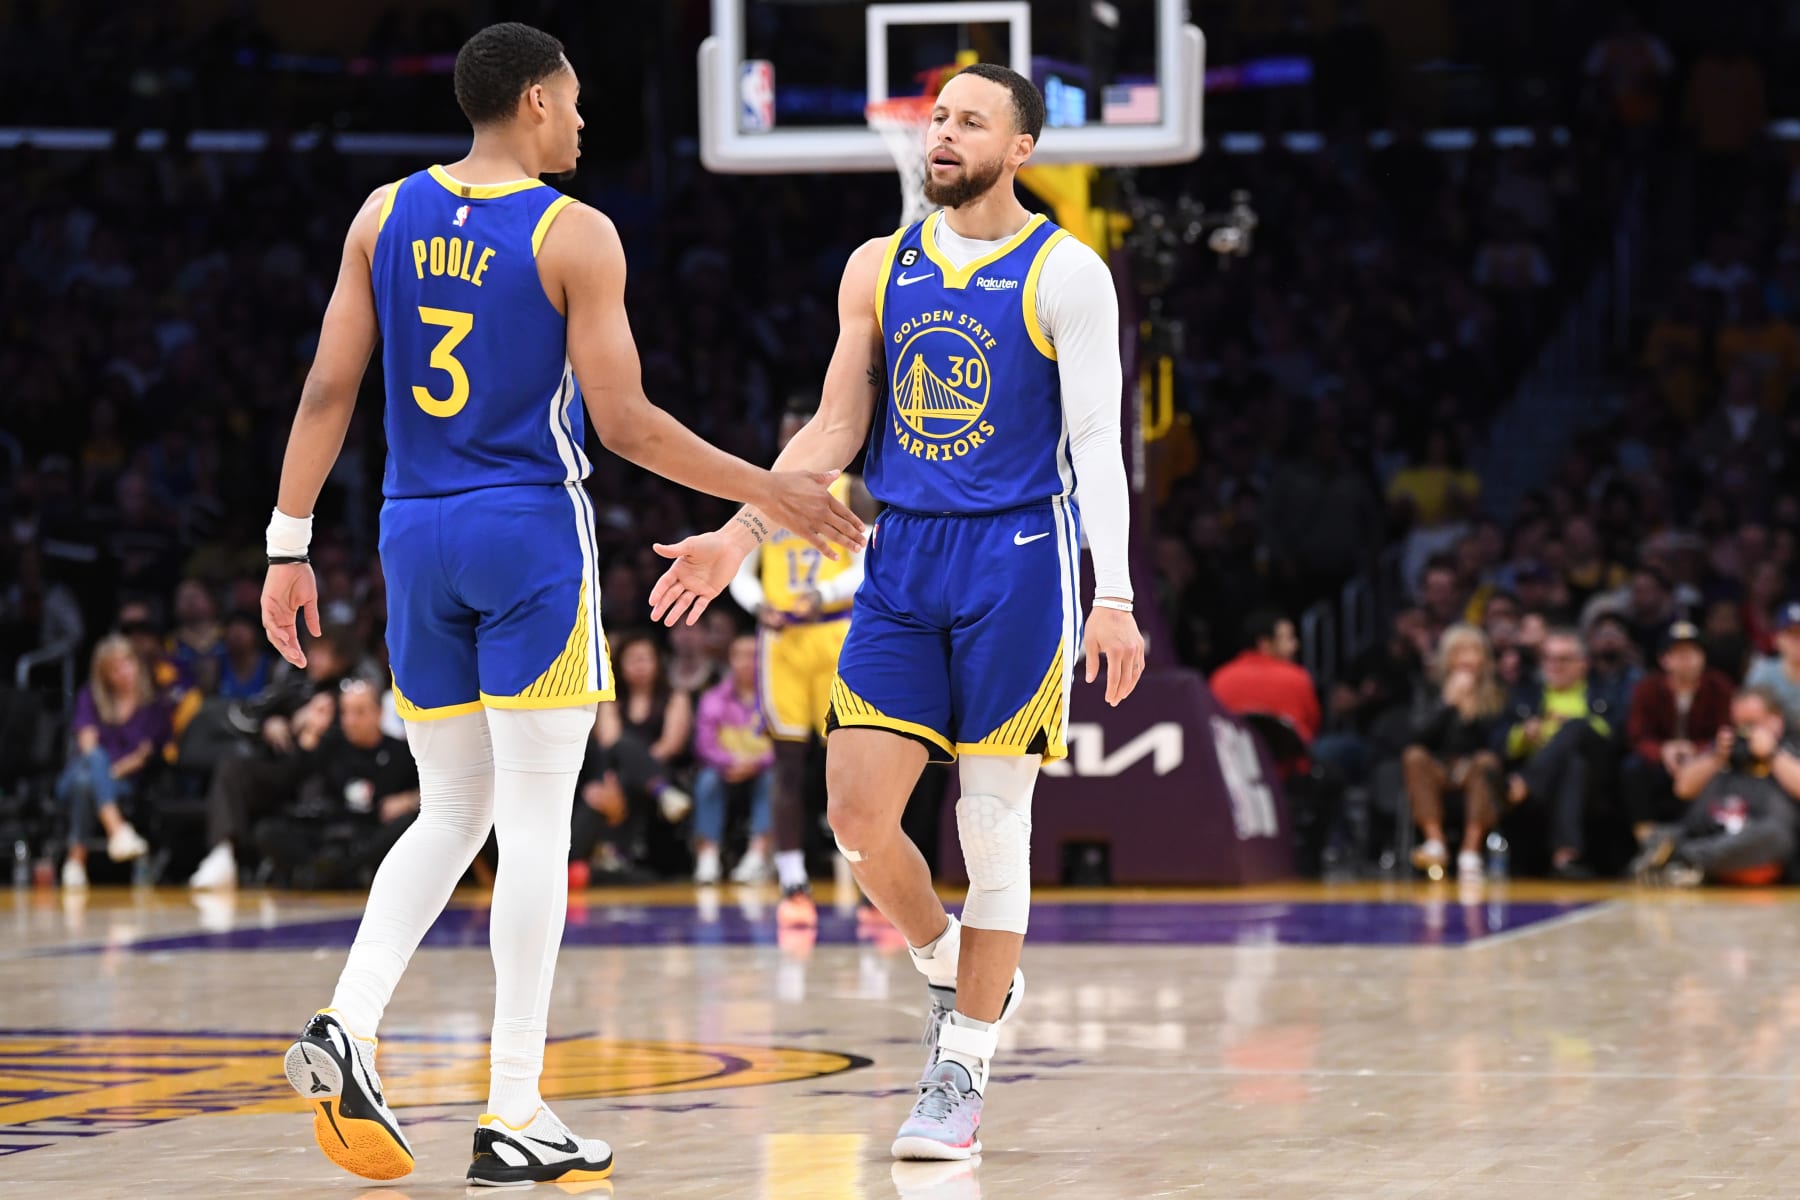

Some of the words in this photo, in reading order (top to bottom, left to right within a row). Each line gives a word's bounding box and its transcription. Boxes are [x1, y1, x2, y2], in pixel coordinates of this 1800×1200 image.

[411, 236, 496, 287] POOLE
[901, 249, 918, 266] 6
[975, 276, 1018, 290] Rakuten
[893, 309, 954, 344] GOLDEN
[958, 314, 997, 350] STATE
[411, 305, 474, 418] 3
[946, 355, 983, 390] 30
[786, 548, 822, 588] 17
